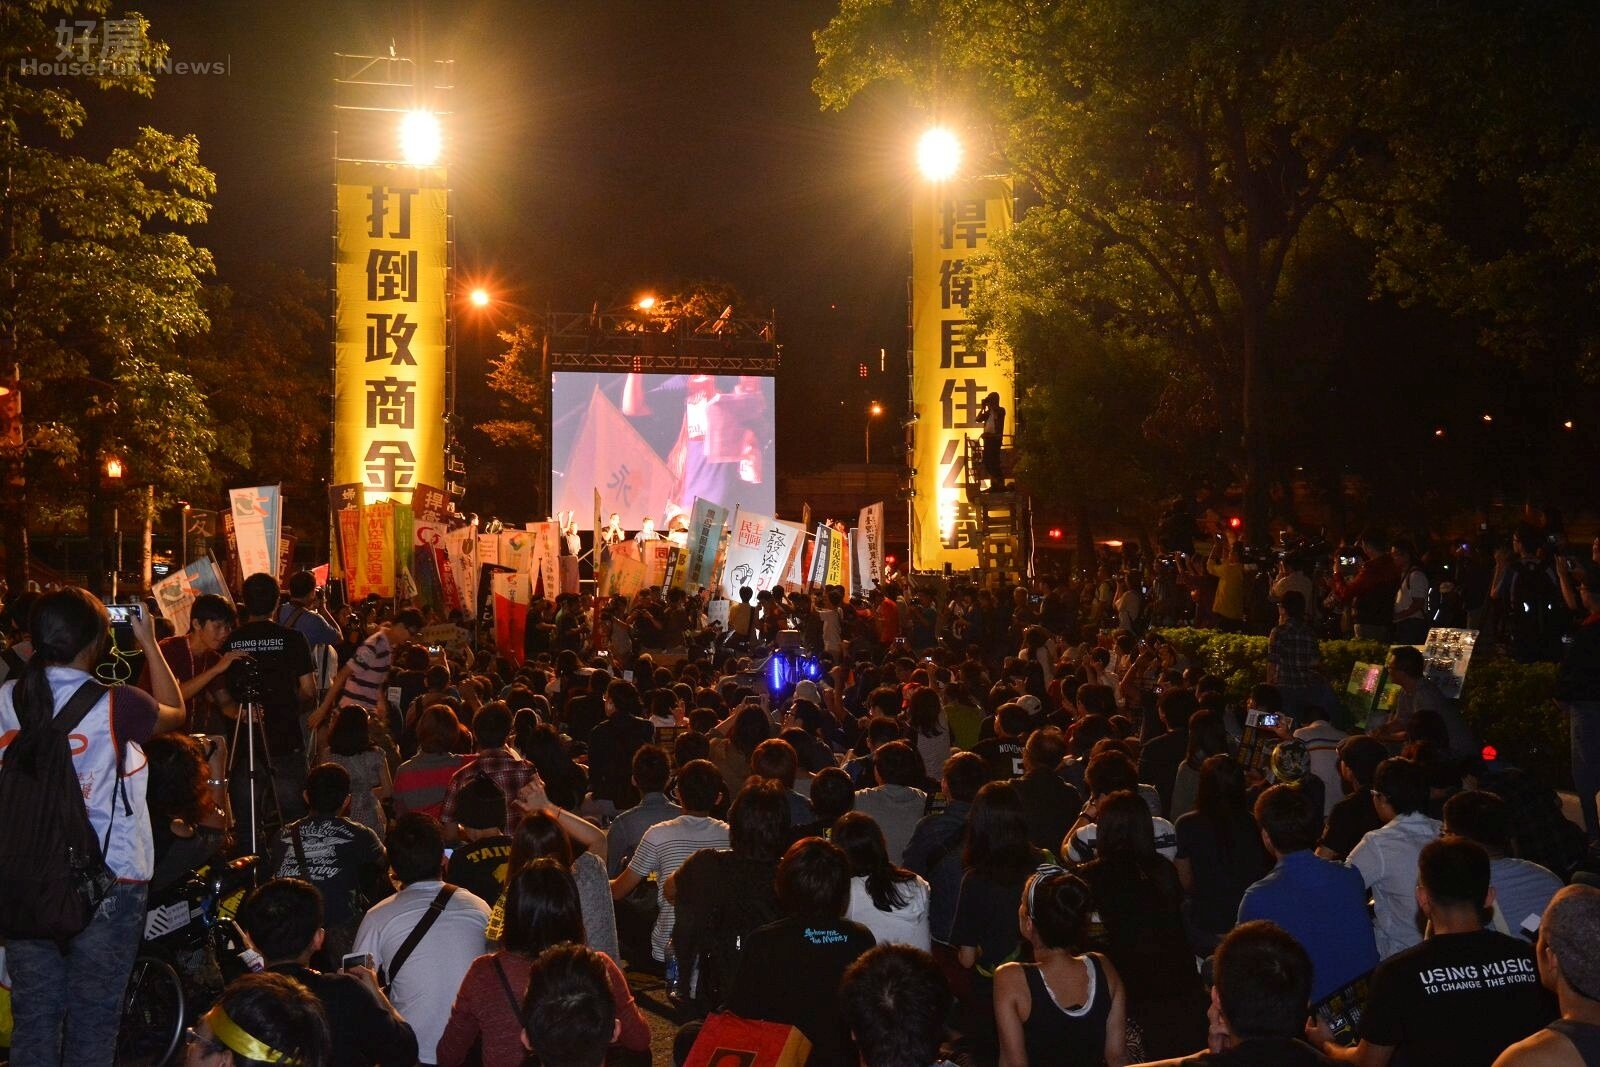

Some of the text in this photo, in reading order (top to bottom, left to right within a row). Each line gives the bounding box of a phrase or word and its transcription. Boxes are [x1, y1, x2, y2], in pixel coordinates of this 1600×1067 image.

[364, 186, 419, 493] 打倒政商金
[741, 519, 762, 536] 民主
[231, 639, 257, 649] USING
[258, 638, 284, 647] MUSIC
[822, 934, 849, 944] Money
[1419, 957, 1534, 986] USING MUSIC
[1424, 972, 1537, 995] TO CHANGE THE WORLD
